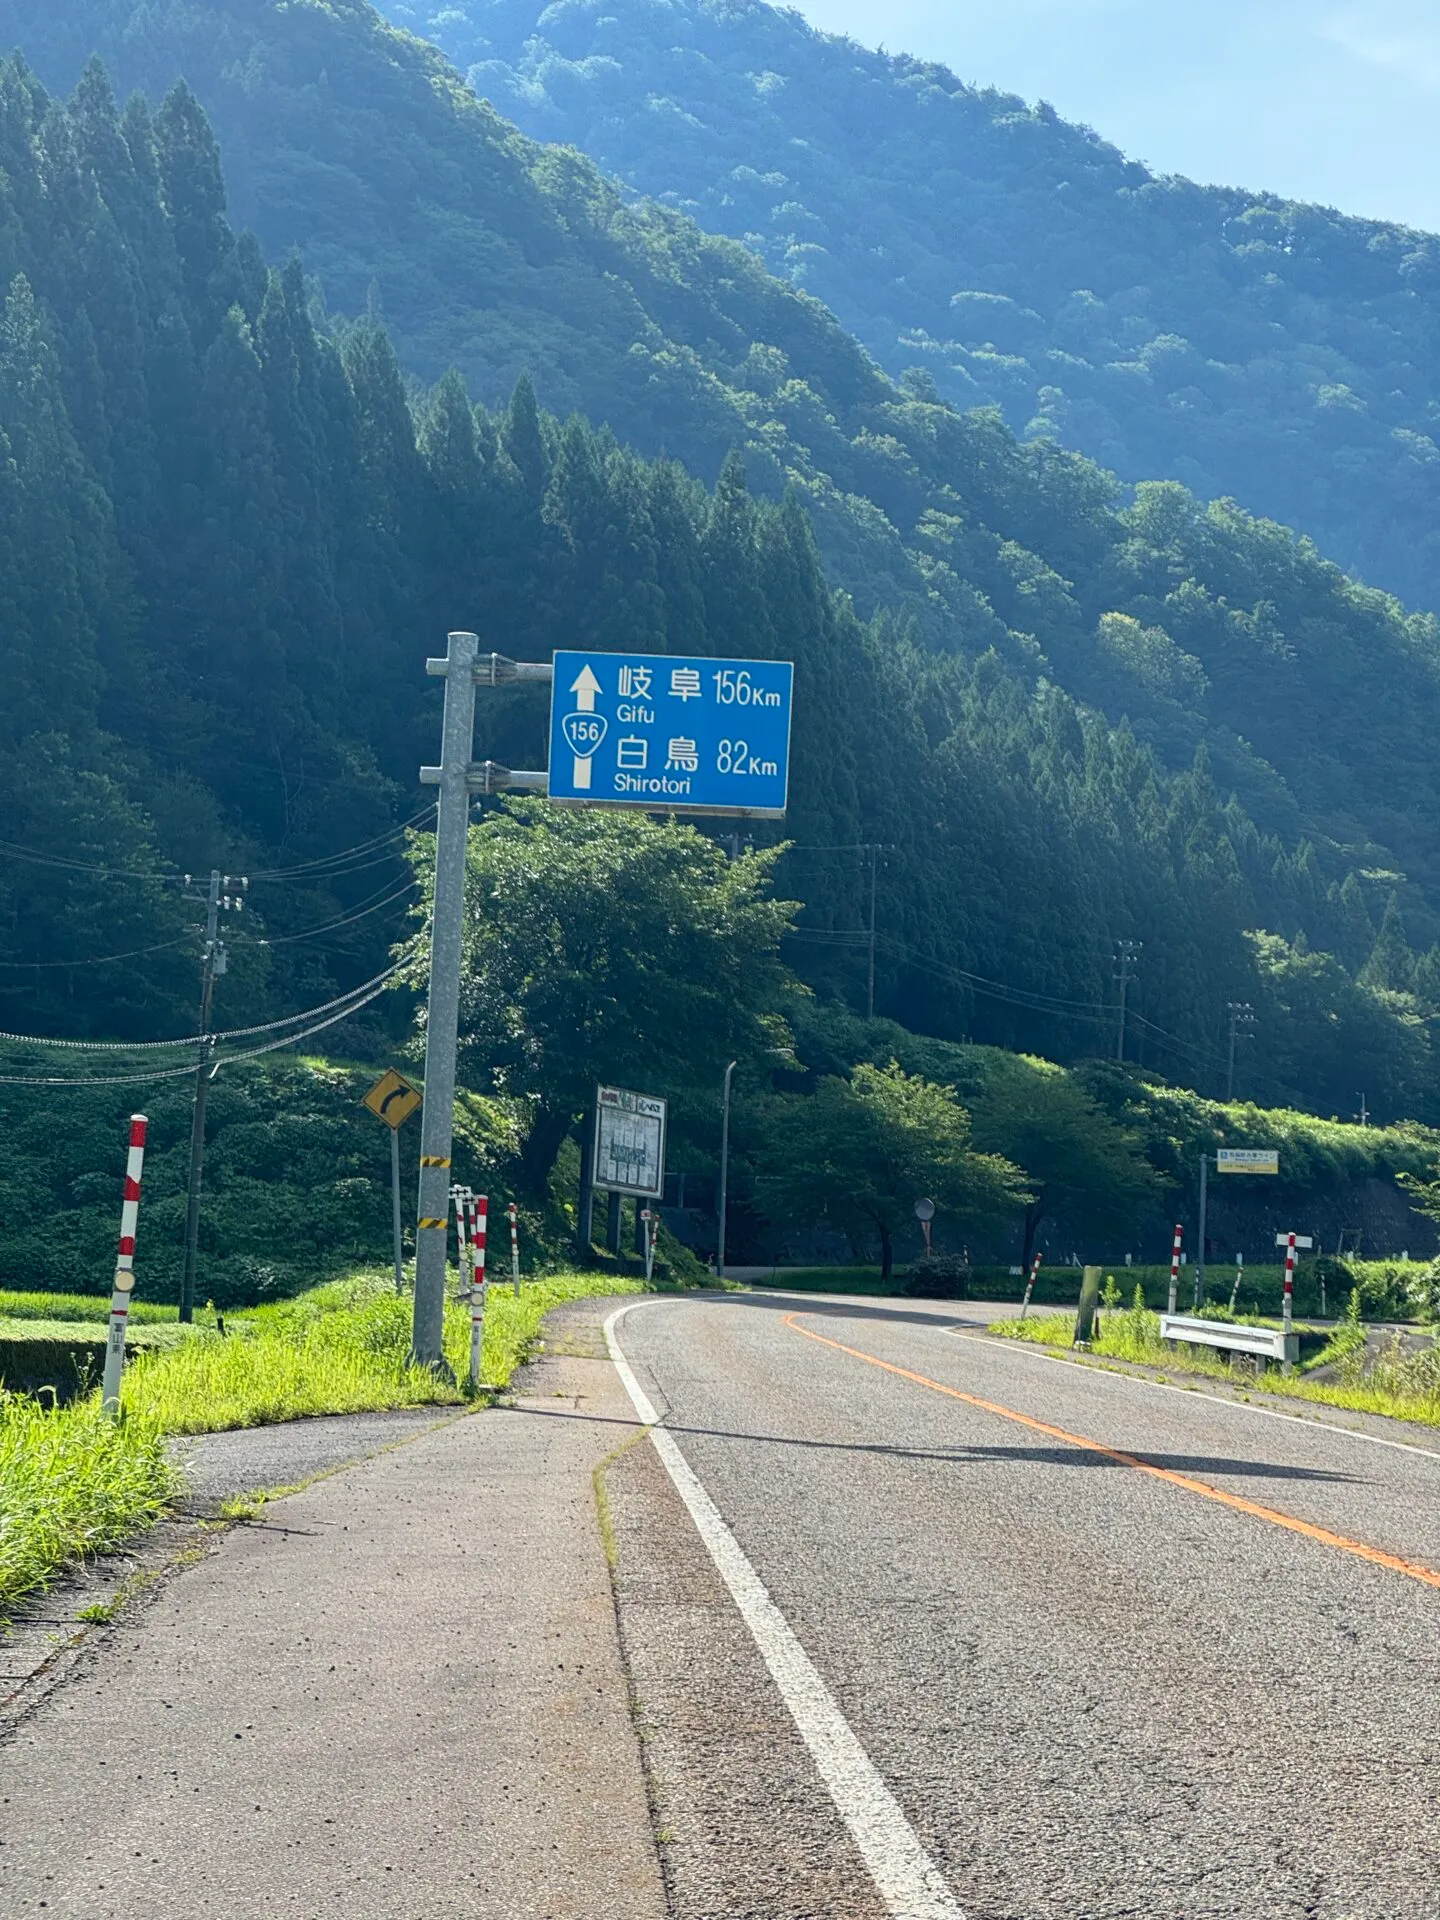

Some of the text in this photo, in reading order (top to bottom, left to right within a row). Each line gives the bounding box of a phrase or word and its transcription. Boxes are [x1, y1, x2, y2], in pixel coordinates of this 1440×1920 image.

[617, 665, 781, 706] 岐阜 156Km
[616, 704, 655, 723] Gifu
[570, 721, 599, 741] 156
[616, 734, 778, 776] 白鳥 82Km
[614, 773, 691, 794] Shirotori
